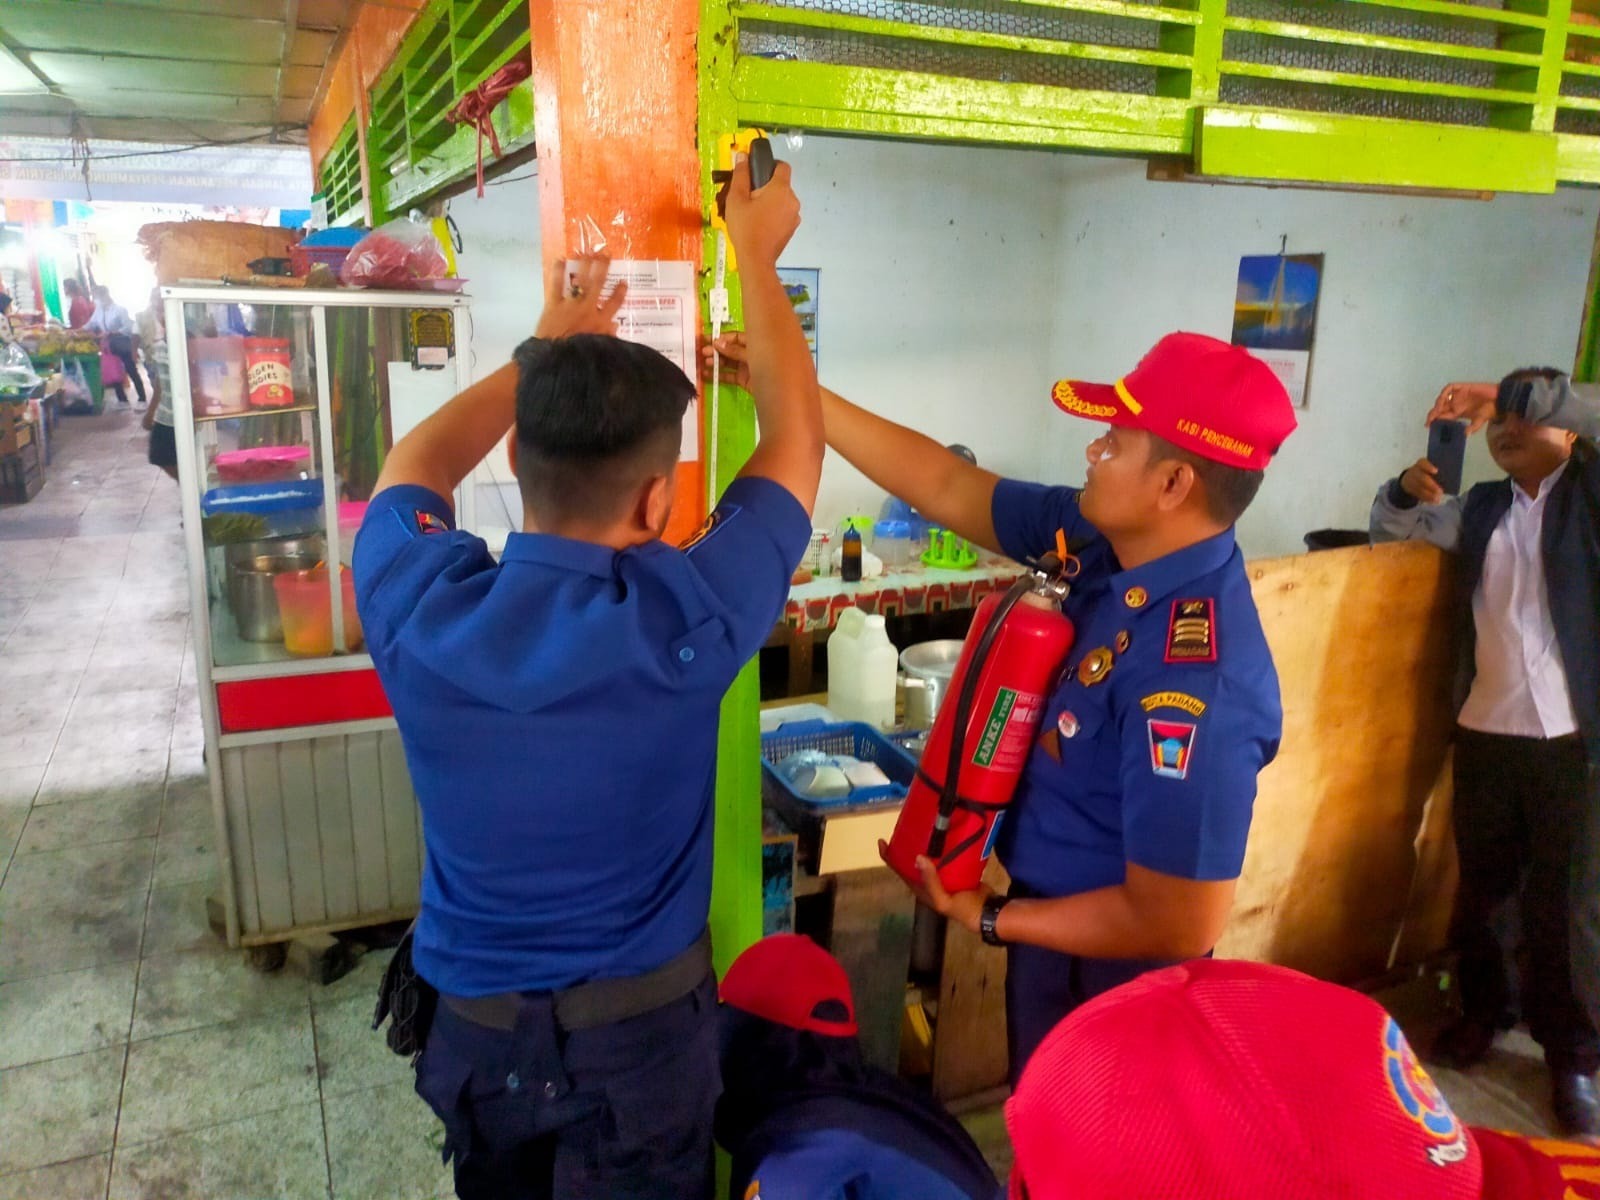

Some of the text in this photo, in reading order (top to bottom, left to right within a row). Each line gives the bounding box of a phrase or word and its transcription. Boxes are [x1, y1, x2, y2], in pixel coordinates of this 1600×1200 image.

[1176, 418, 1200, 437] KASI
[1166, 694, 1202, 713] PADANG
[979, 718, 1002, 764] ANKE
